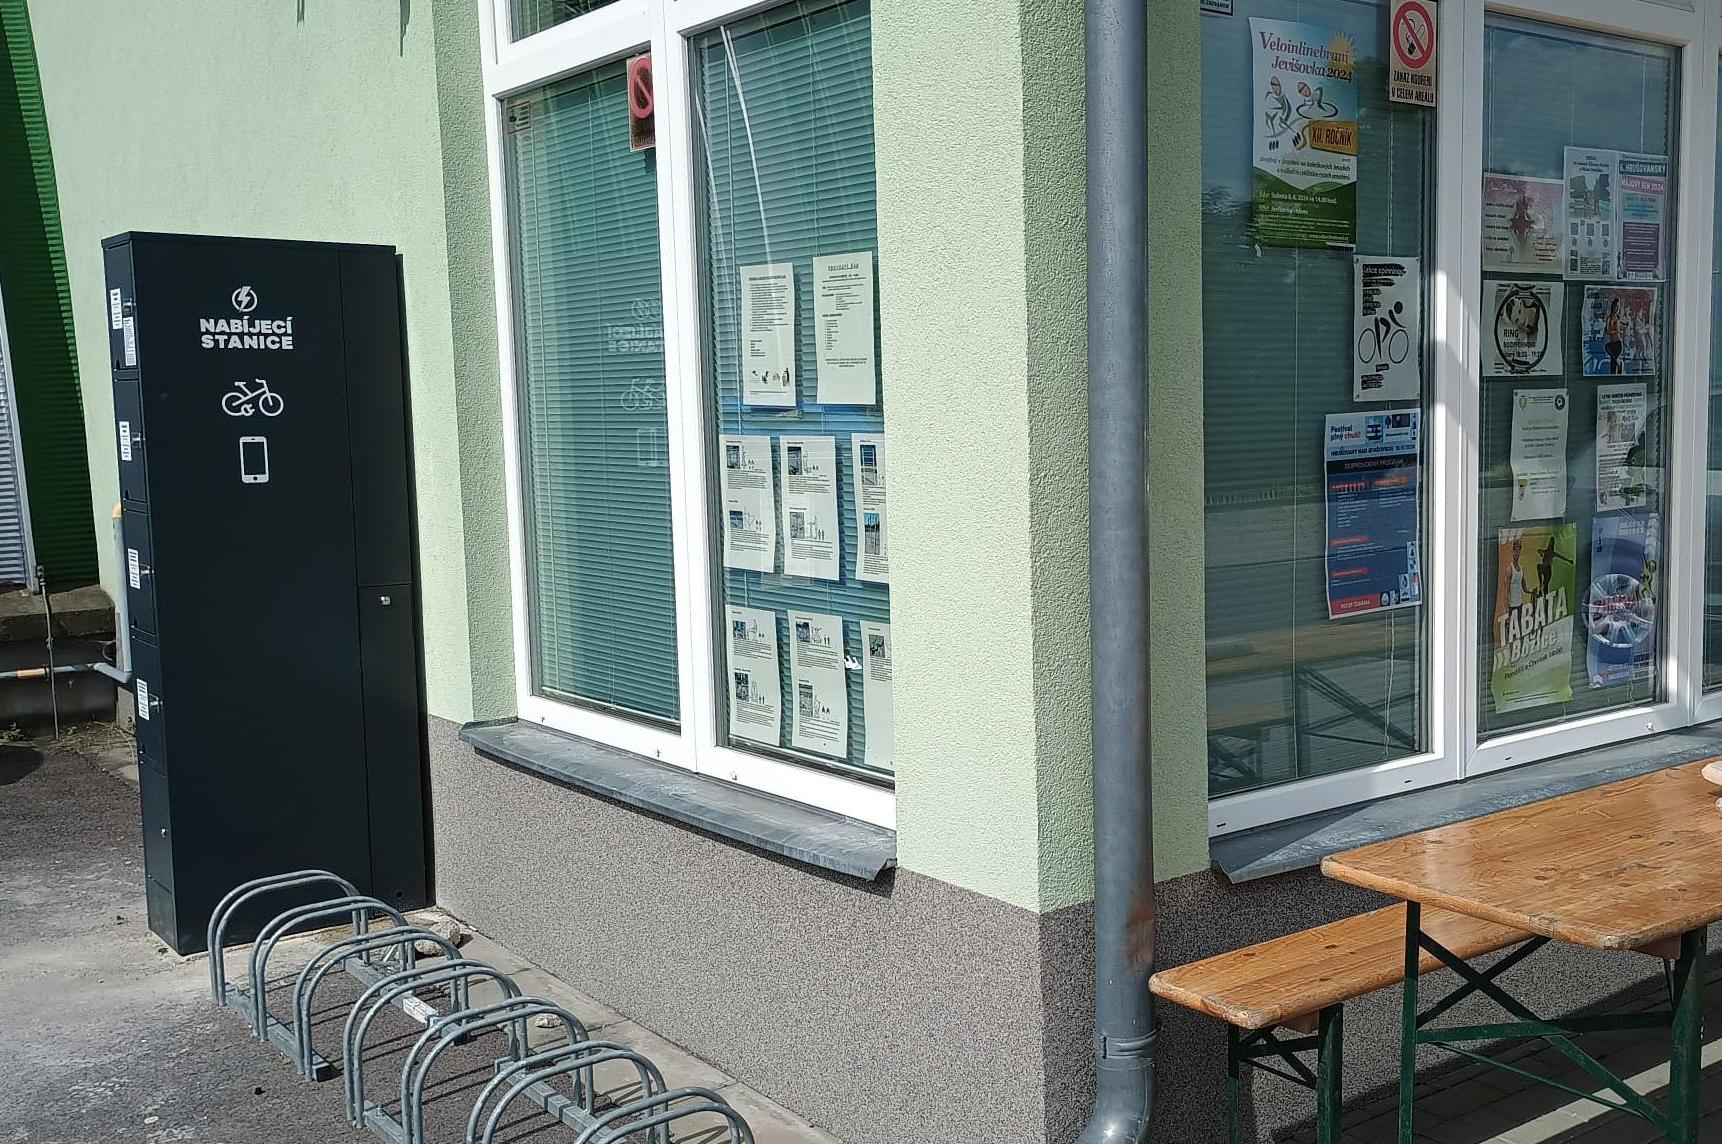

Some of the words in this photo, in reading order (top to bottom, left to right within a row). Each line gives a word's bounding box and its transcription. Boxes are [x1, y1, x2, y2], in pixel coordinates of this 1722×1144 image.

[1271, 56, 1327, 77] Jevišovka
[1327, 68, 1352, 83] 2024
[1391, 86, 1396, 97] V
[1325, 126, 1353, 147] ROČNÍK
[200, 315, 293, 334] NABÍJECÍ
[1504, 328, 1519, 338] RING
[201, 334, 294, 349] STANICE
[1498, 586, 1567, 647] TABATA
